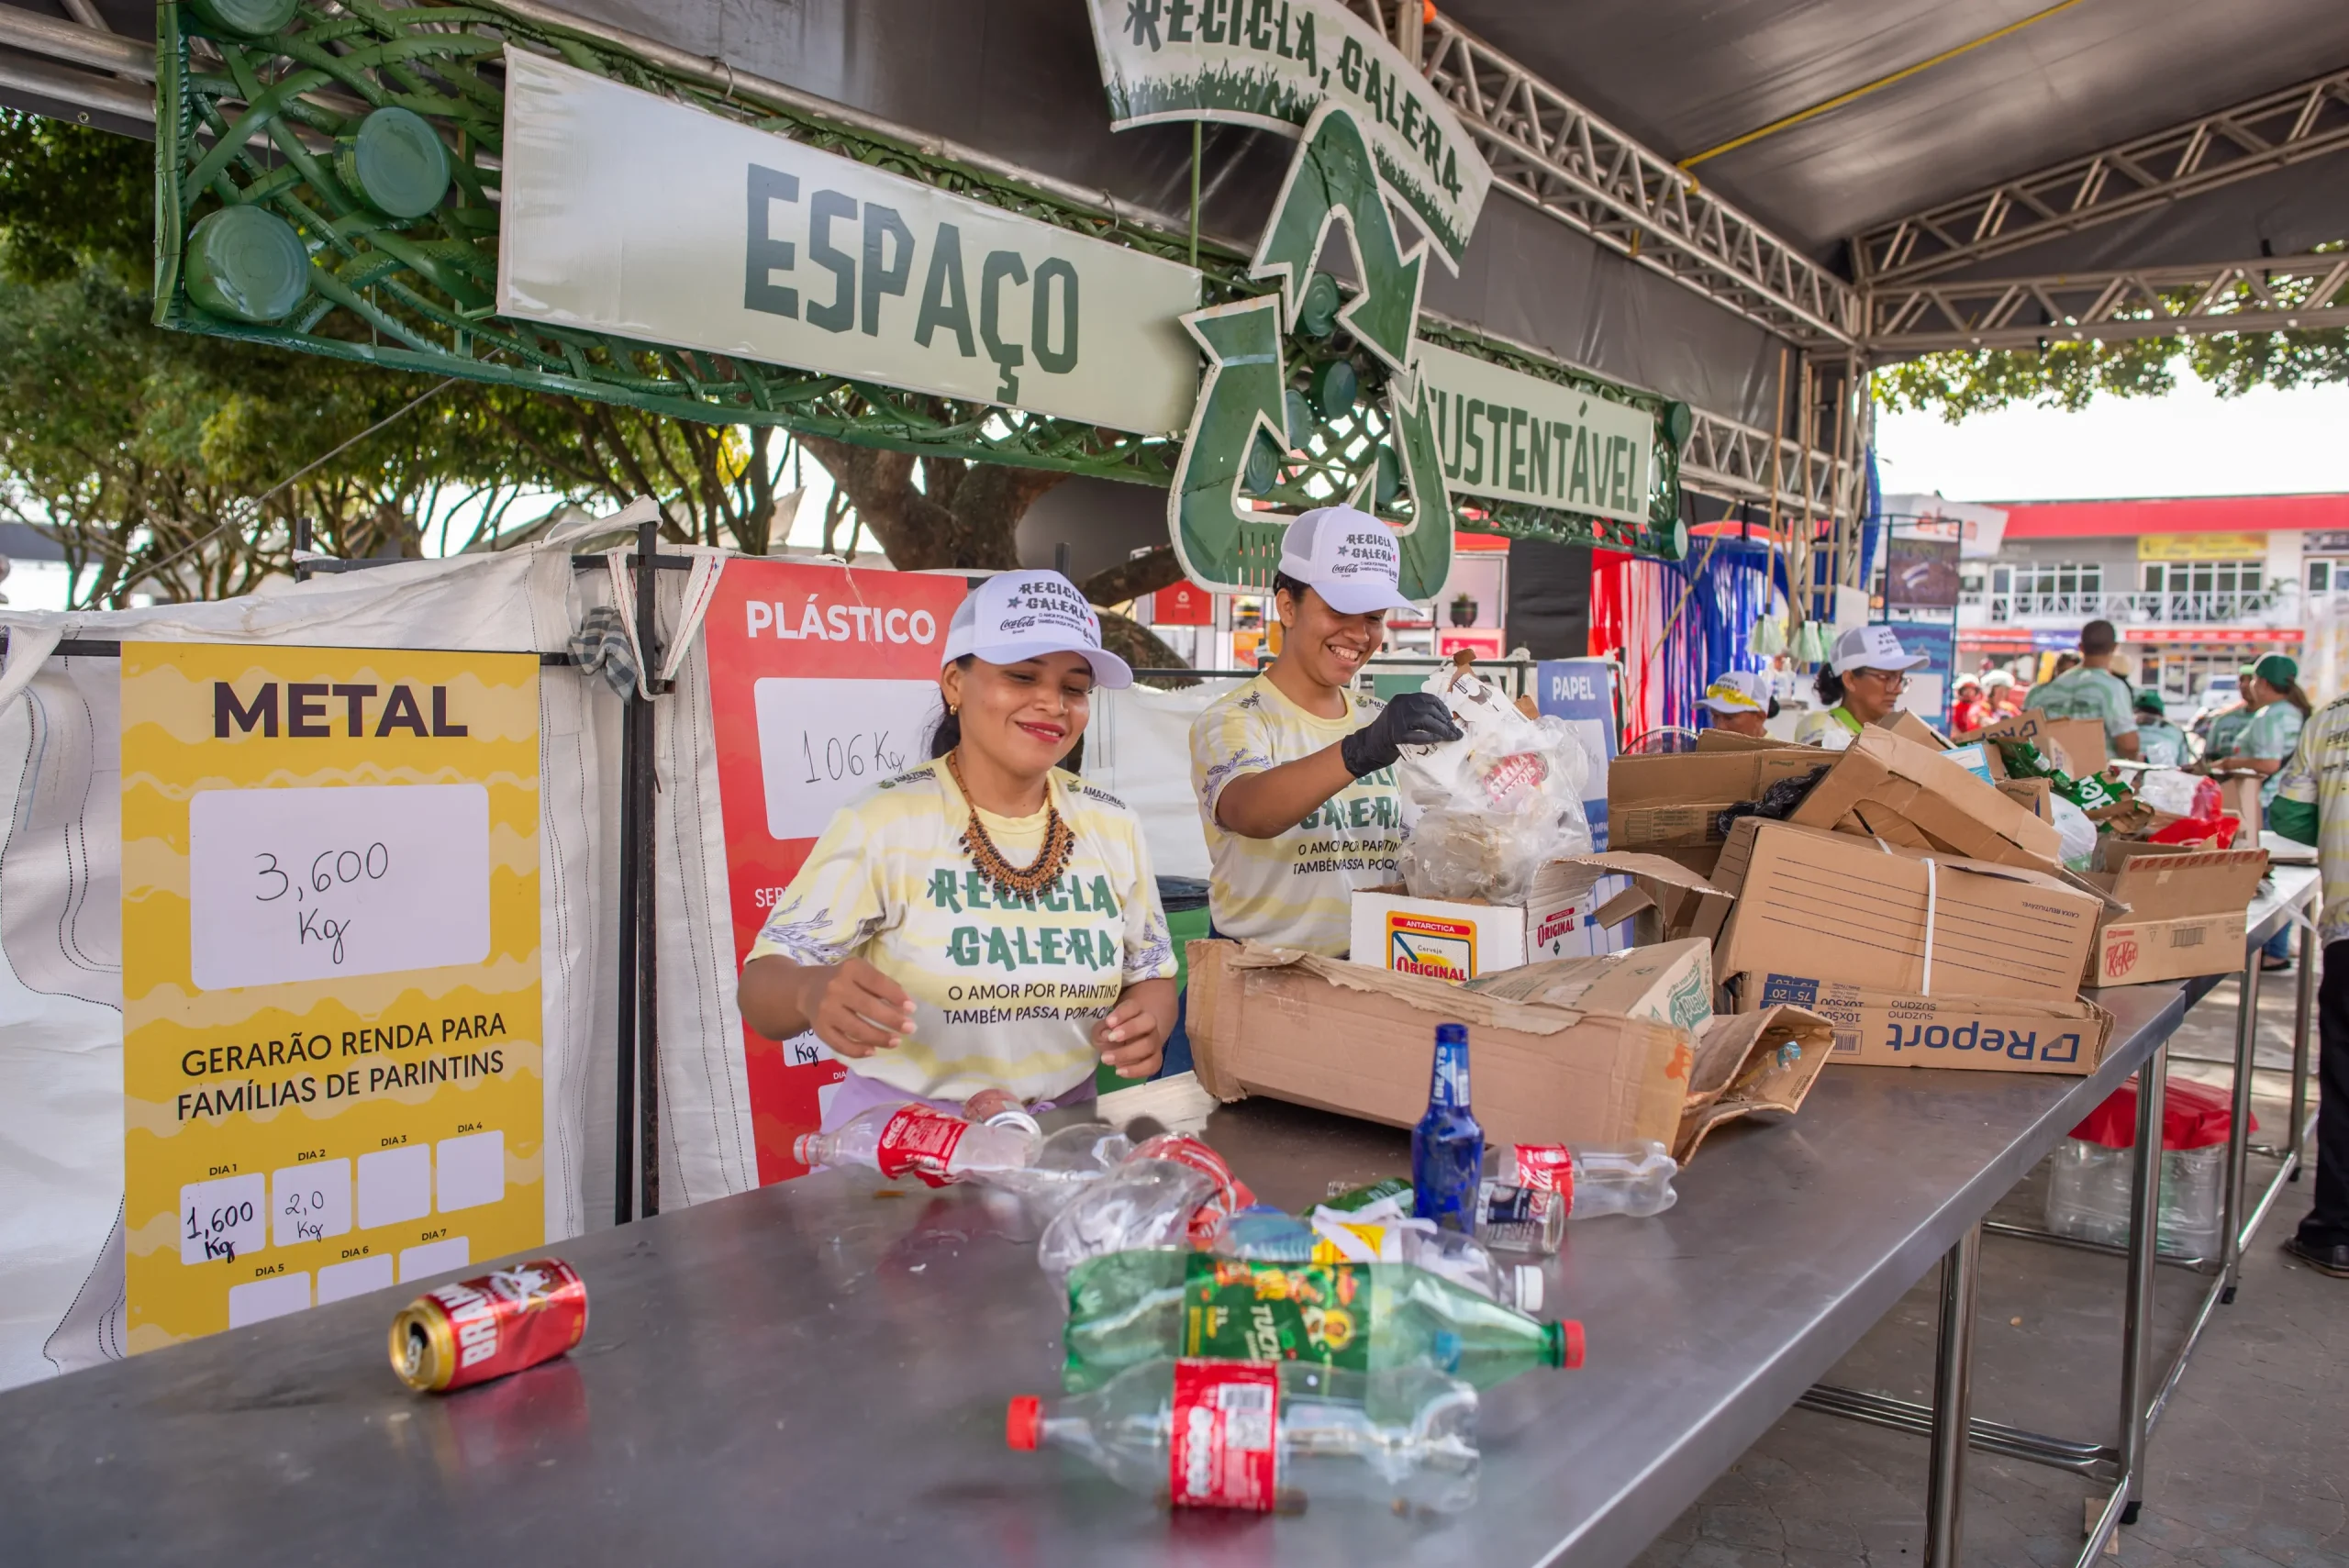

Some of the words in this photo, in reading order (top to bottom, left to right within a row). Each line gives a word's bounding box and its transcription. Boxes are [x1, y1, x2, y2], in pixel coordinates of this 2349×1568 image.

[1337, 35, 1463, 205] GALERA
[744, 161, 1079, 405] ESPAÇO
[746, 594, 936, 645] PLÁSTICO
[1000, 616, 1037, 631] Coca-Cola
[1553, 676, 1597, 702] PAPEL
[214, 682, 469, 739] METAL
[804, 730, 864, 784] 106
[1083, 785, 1127, 810] AMAZONAS
[1298, 844, 1307, 856] O
[255, 842, 390, 903] 3,600
[2021, 901, 2062, 915] REUTILIZÁVEL
[2062, 910, 2080, 918] CAIXA
[298, 910, 351, 964] Kg
[1406, 920, 1455, 934] ANTARCTICA
[1537, 917, 1575, 949] ORIGINAL
[946, 926, 1118, 972] GALERA
[1417, 944, 1443, 954] Cerveja
[1396, 956, 1467, 982] ORIGINAL
[948, 985, 963, 1001] O
[968, 984, 1019, 1000] AMOR
[1024, 983, 1055, 998] POR
[1060, 984, 1119, 998] PARINTINS
[1772, 988, 1787, 999] 20
[1797, 990, 1811, 1001] 75
[1891, 999, 1936, 1010] suzano
[943, 1006, 1011, 1024] TAMBÉM
[1016, 1006, 1060, 1021] PASSA
[1064, 1007, 1089, 1021] POR
[1888, 1010, 1933, 1021] suzano
[182, 1031, 332, 1076] GERARÃO
[342, 1021, 433, 1056] RENDA
[442, 1012, 507, 1042] PARA
[1886, 1020, 2037, 1061] Report
[1433, 1046, 1448, 1098] BEATS
[178, 1079, 317, 1120] FAMÍLIAS
[327, 1071, 361, 1099] DE
[370, 1050, 504, 1092] PARINTINS
[457, 1124, 474, 1133] DIA
[381, 1136, 399, 1147] DIA
[401, 1135, 407, 1143] 3
[297, 1151, 317, 1162] DIA
[319, 1149, 326, 1158] 2
[209, 1165, 229, 1176] DIA
[232, 1163, 238, 1173] 1
[186, 1201, 253, 1240] 1,600
[297, 1220, 324, 1242] Kg
[421, 1230, 439, 1240] DIA
[440, 1229, 447, 1237] 7
[205, 1236, 236, 1264] Kg
[341, 1248, 361, 1258] DIA
[362, 1246, 369, 1254] 6
[255, 1265, 275, 1276] DIA
[278, 1263, 284, 1273] 5
